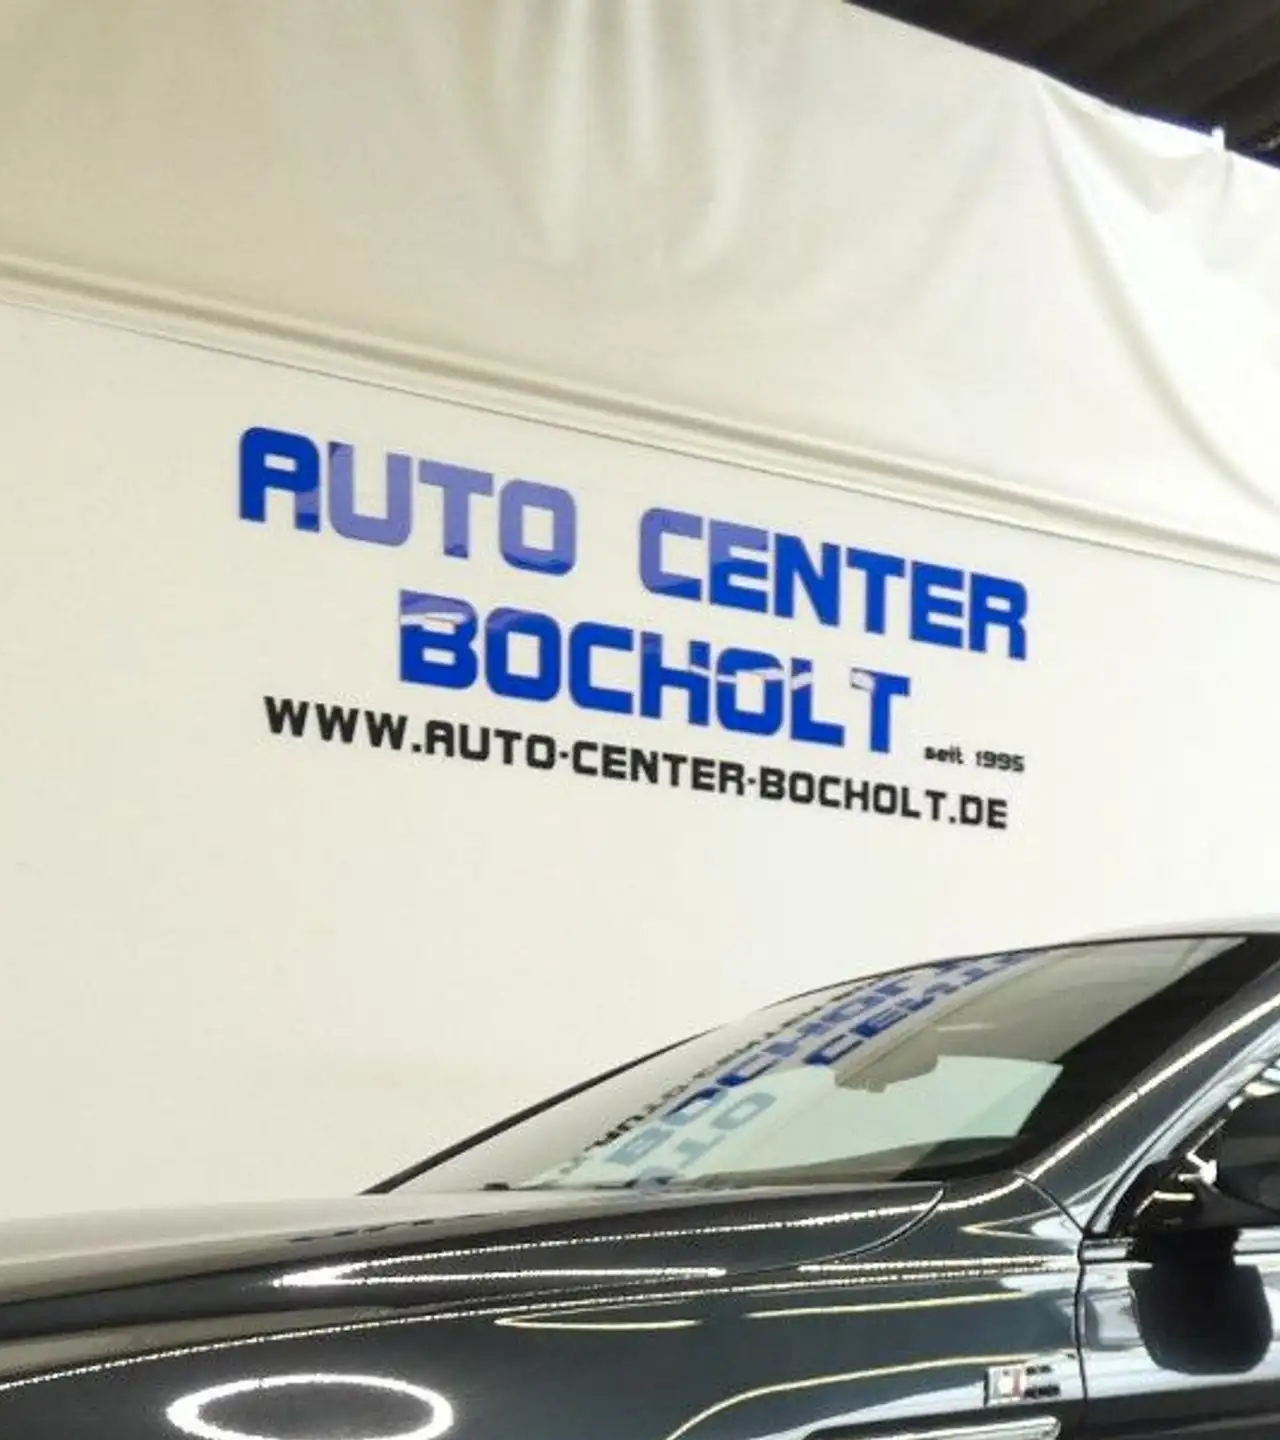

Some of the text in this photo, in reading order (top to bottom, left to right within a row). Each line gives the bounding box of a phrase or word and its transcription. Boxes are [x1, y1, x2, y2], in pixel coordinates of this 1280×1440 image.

[237, 426, 1029, 661] AUTO CENTER
[398, 589, 911, 754] BOCHOLT
[263, 695, 1008, 830] WWW.AUTO-CENTER-BOCHOLT.DE
[924, 744, 1025, 773] seit 1995
